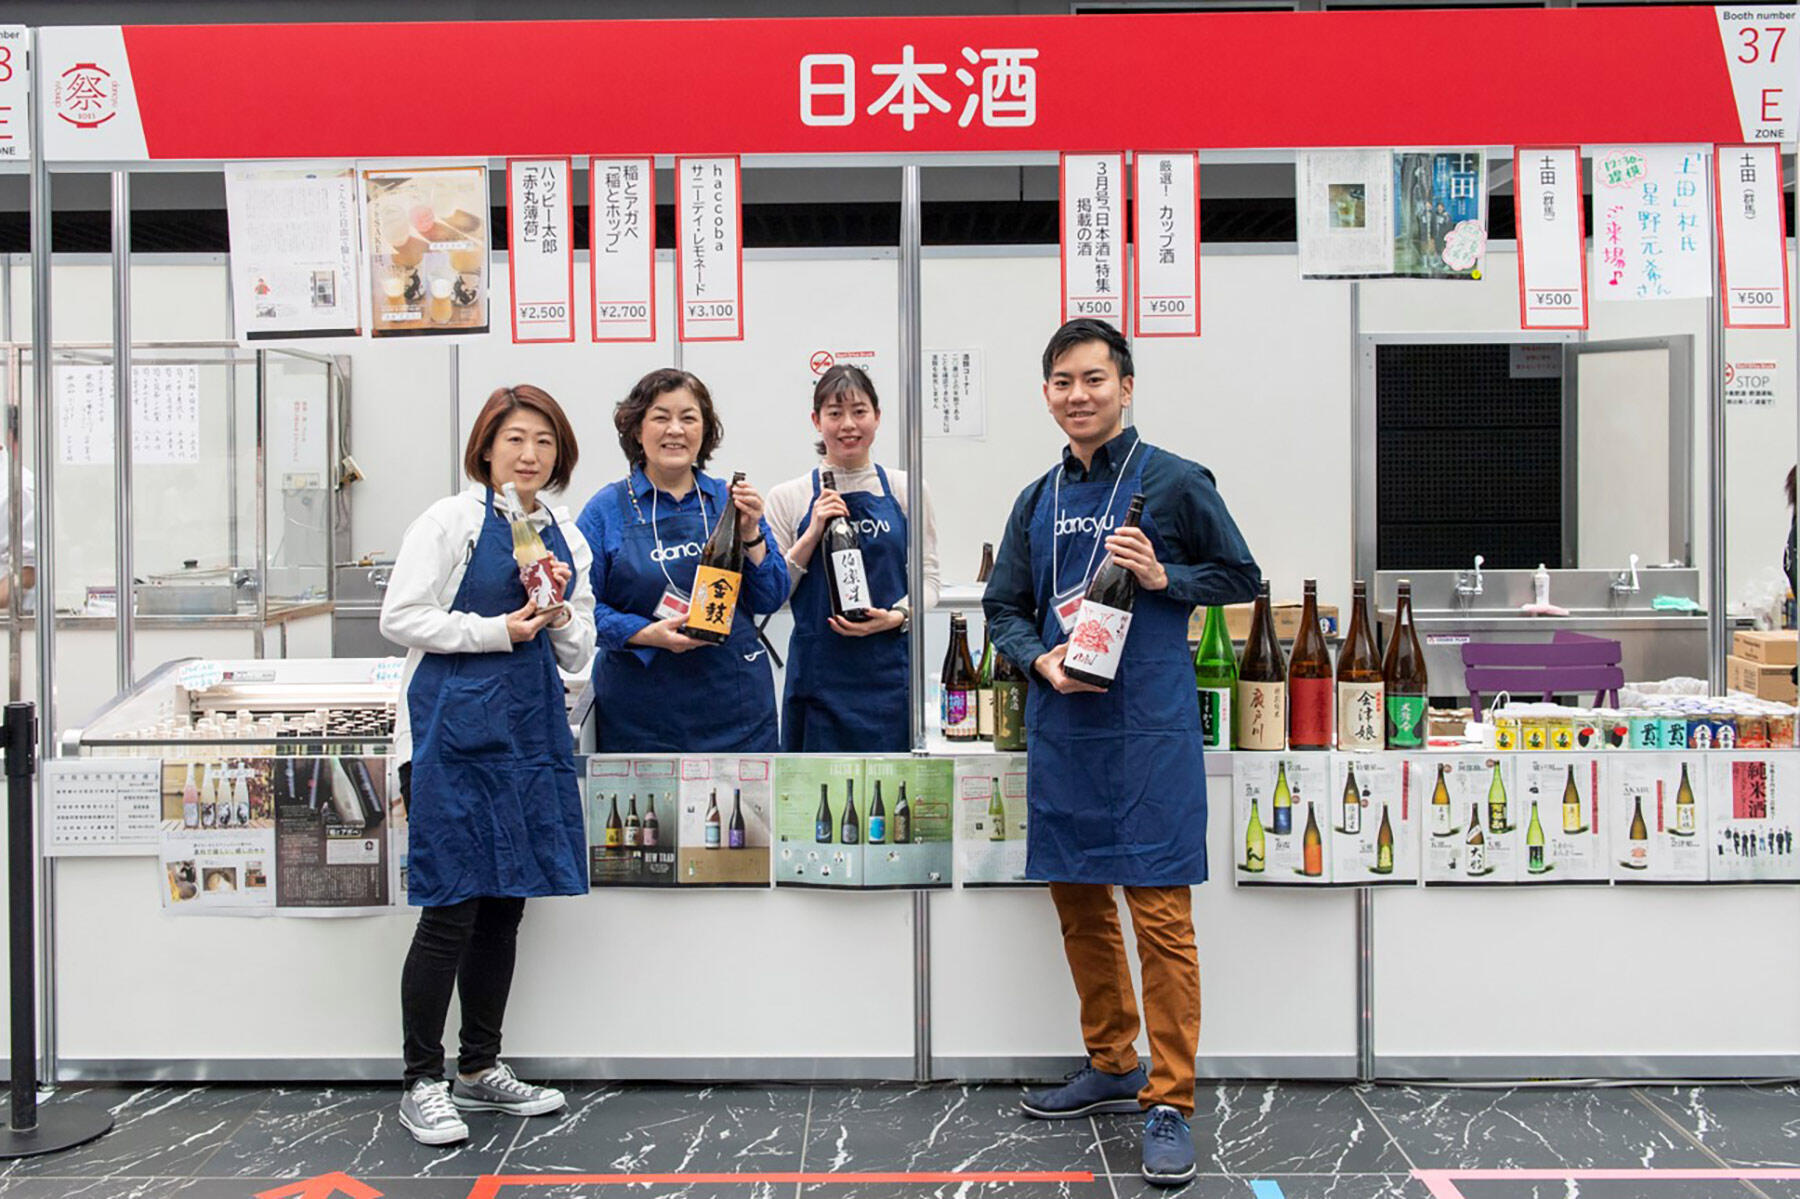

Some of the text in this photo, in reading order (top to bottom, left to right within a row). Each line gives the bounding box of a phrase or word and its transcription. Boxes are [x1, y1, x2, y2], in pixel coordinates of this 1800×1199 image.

[1723, 11, 1796, 20] Booth number
[1738, 27, 1786, 64] 37
[65, 73, 107, 111] 祭
[799, 44, 1040, 132] 日本酒
[1761, 89, 1783, 122] E
[1755, 129, 1784, 139] ZONE
[1450, 153, 1476, 199] 土田
[1539, 155, 1556, 186] 土田
[1740, 152, 1756, 183] 土田
[540, 166, 558, 254] ハッピー太郎
[605, 166, 621, 254] 「稲とホップ」
[623, 164, 639, 239] 稲とアガベ
[713, 164, 724, 252] haccoba
[1077, 198, 1092, 257] 掲載の酒
[1159, 205, 1175, 264] カップ酒
[1077, 301, 1112, 314] ¥500
[1150, 300, 1185, 313] ¥500
[1536, 293, 1571, 306] ¥500
[1737, 292, 1774, 305] ¥500
[1736, 375, 1770, 388] STOP
[1055, 509, 1115, 538] dancyu
[650, 539, 706, 562] dancy
[705, 578, 733, 625] 金鼓
[1355, 690, 1377, 741] 会津娘
[1748, 761, 1767, 819] 純米酒
